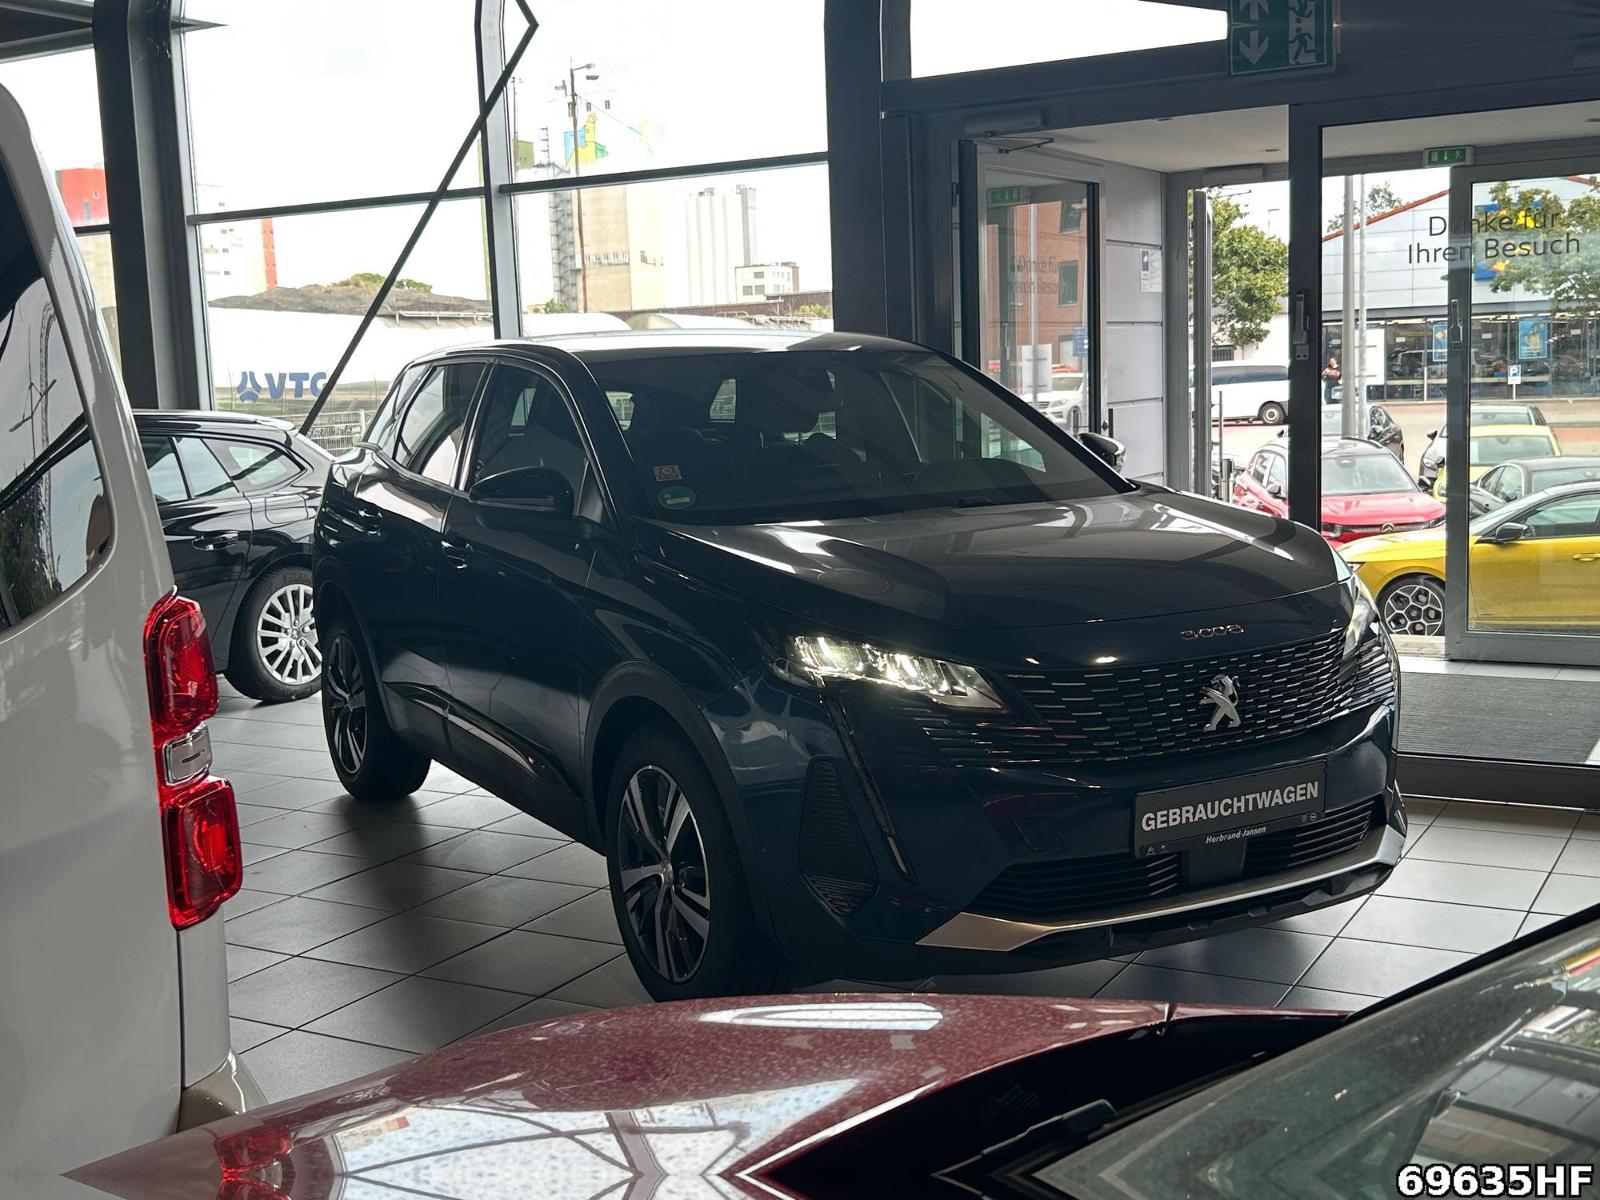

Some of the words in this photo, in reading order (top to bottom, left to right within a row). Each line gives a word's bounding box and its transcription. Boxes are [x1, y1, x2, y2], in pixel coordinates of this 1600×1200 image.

[1408, 242, 1473, 264] Ihren
[1484, 232, 1581, 259] Besuch
[1141, 781, 1320, 831] GEBRAUCHTWAGEN
[1205, 826, 1267, 844] Herbrand-Jansen
